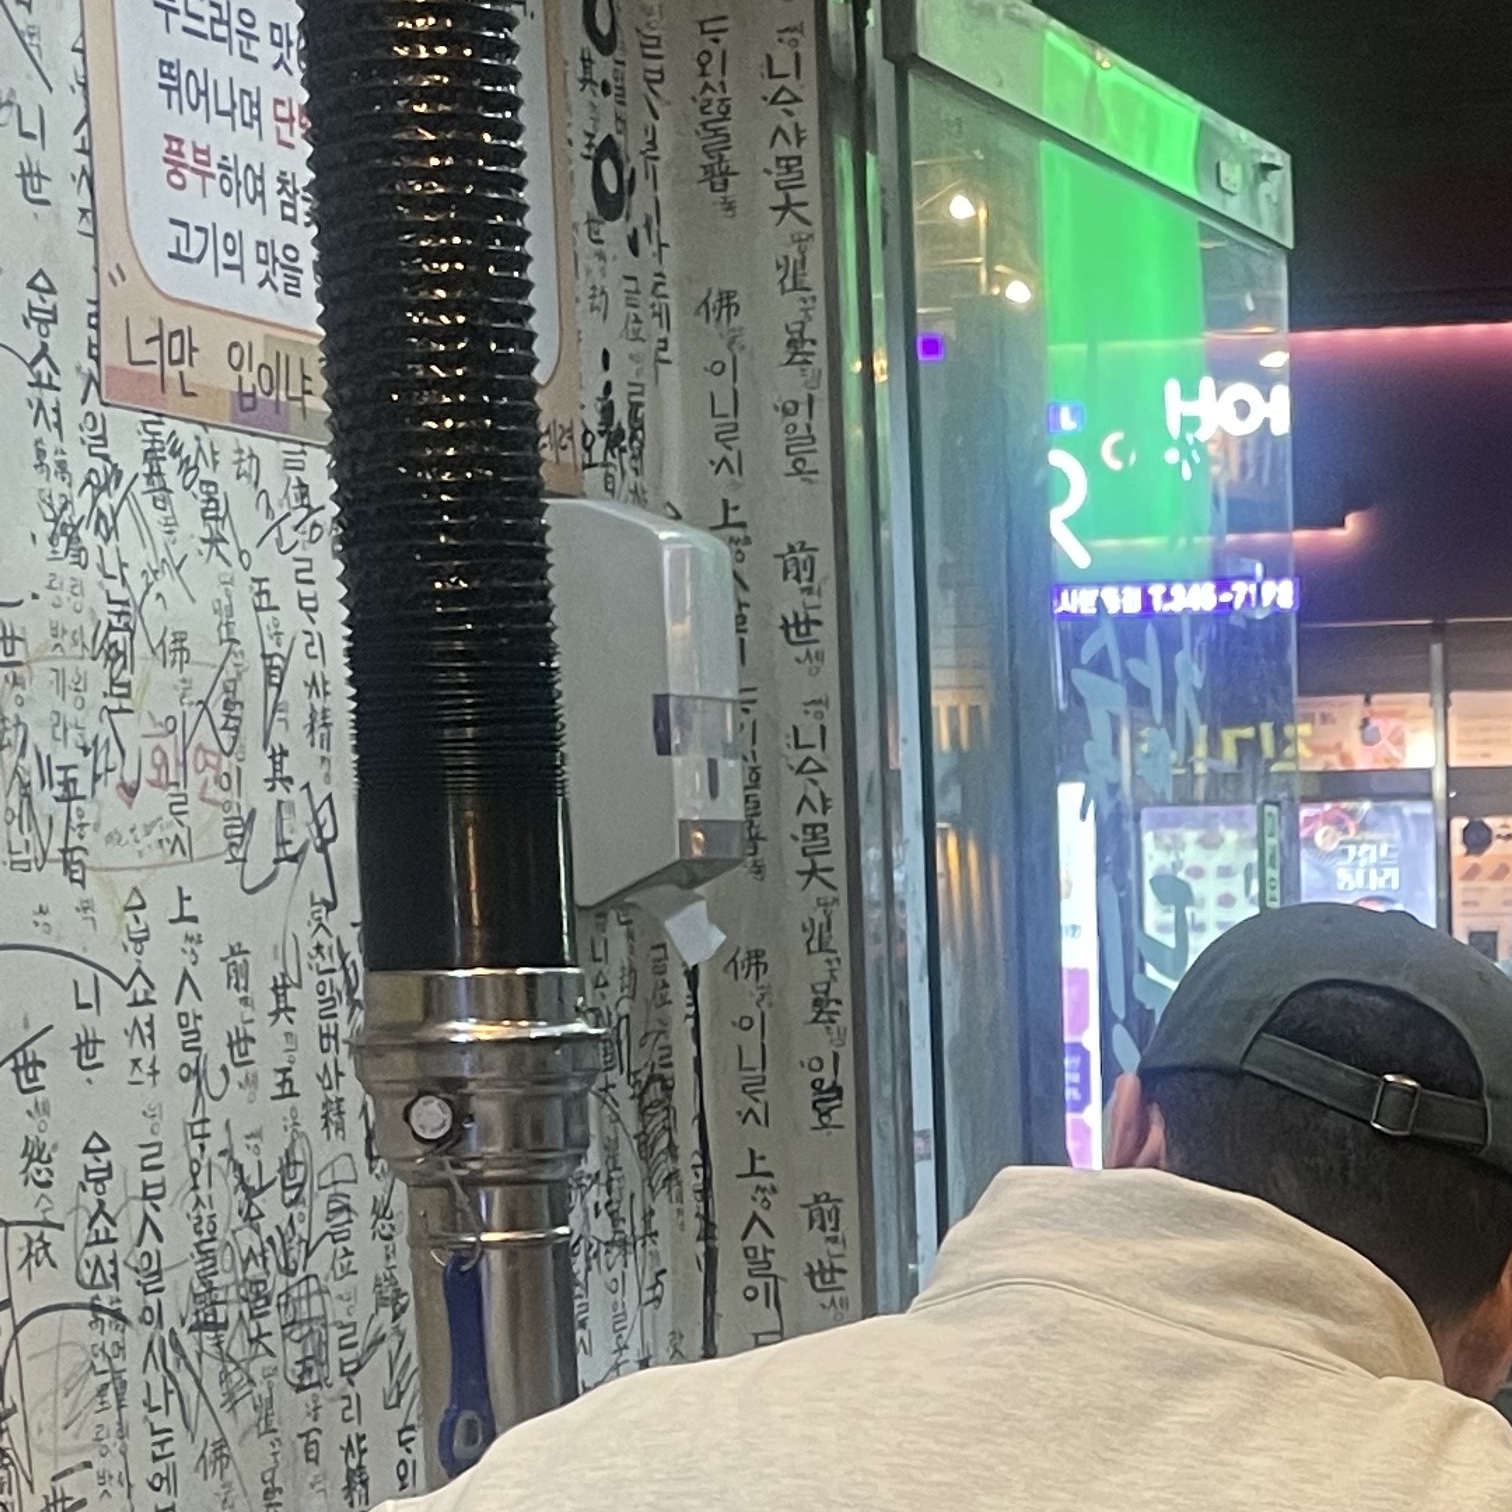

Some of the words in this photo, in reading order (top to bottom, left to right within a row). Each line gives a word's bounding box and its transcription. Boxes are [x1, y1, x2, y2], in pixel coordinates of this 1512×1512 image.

[158, 57, 263, 142] 뛰어나며
[162, 132, 267, 216] 풍부하여
[167, 217, 245, 284] 고기의
[125, 315, 200, 397] 너만
